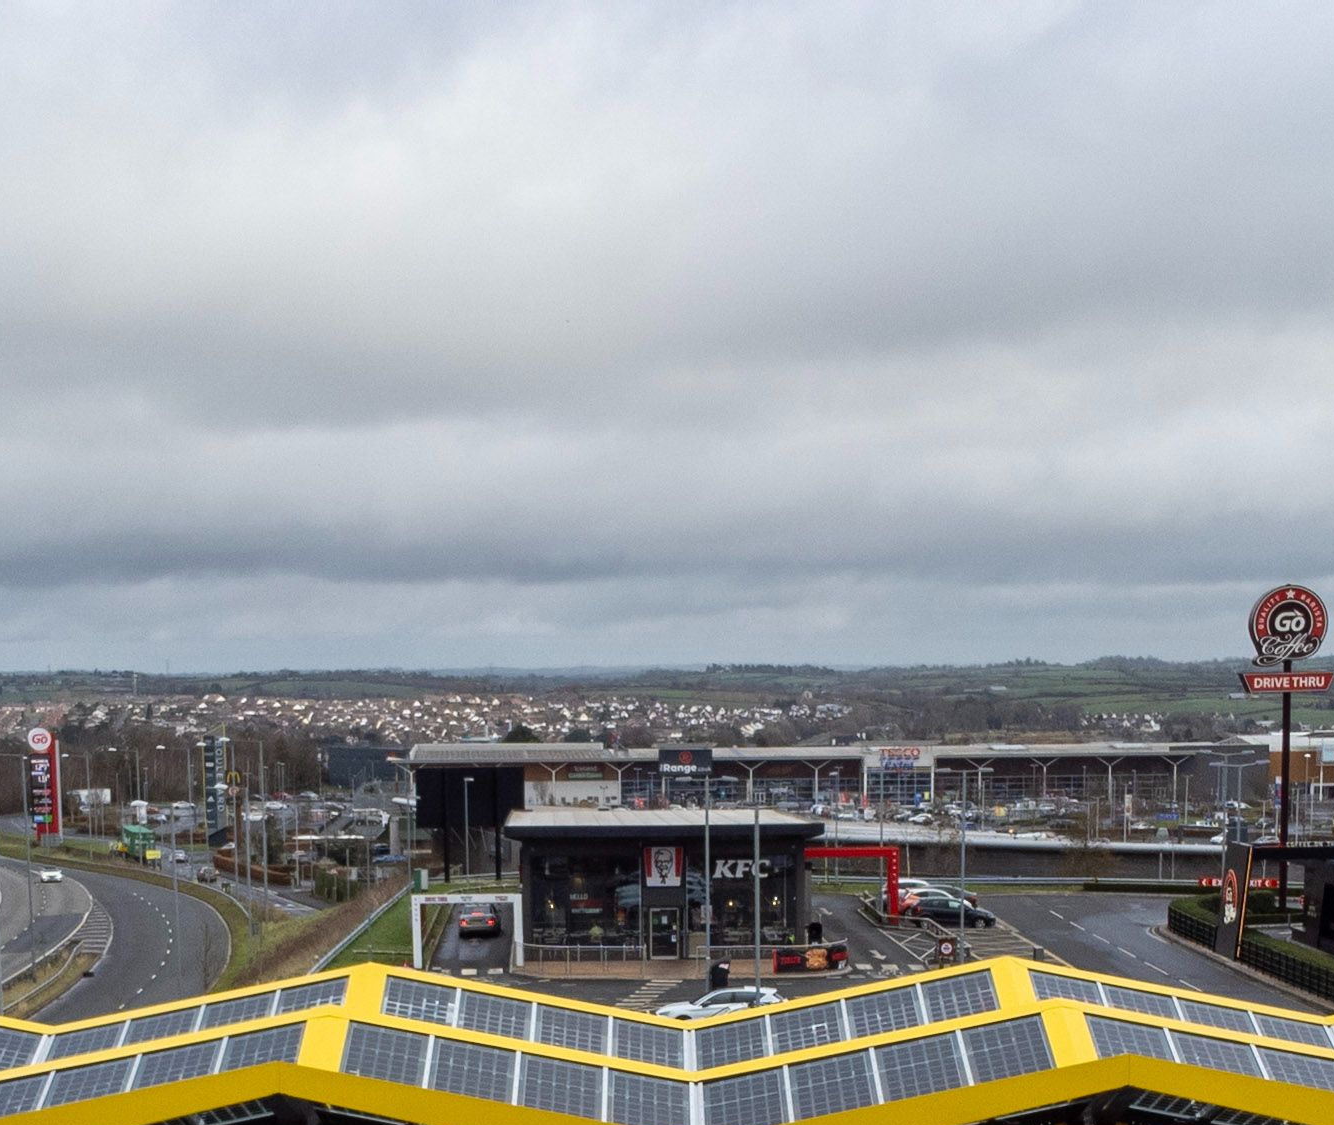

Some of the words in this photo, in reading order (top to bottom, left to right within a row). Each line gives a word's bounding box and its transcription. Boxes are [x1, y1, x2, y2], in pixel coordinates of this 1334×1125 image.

[1258, 595, 1281, 630] QUALITY
[1301, 594, 1323, 628] BARISTA
[1257, 633, 1320, 666] Coffee
[1254, 676, 1290, 689] DRIVE
[1292, 676, 1325, 688] THRU
[215, 738, 225, 813] BOULEARD
[712, 860, 770, 878] KFC
